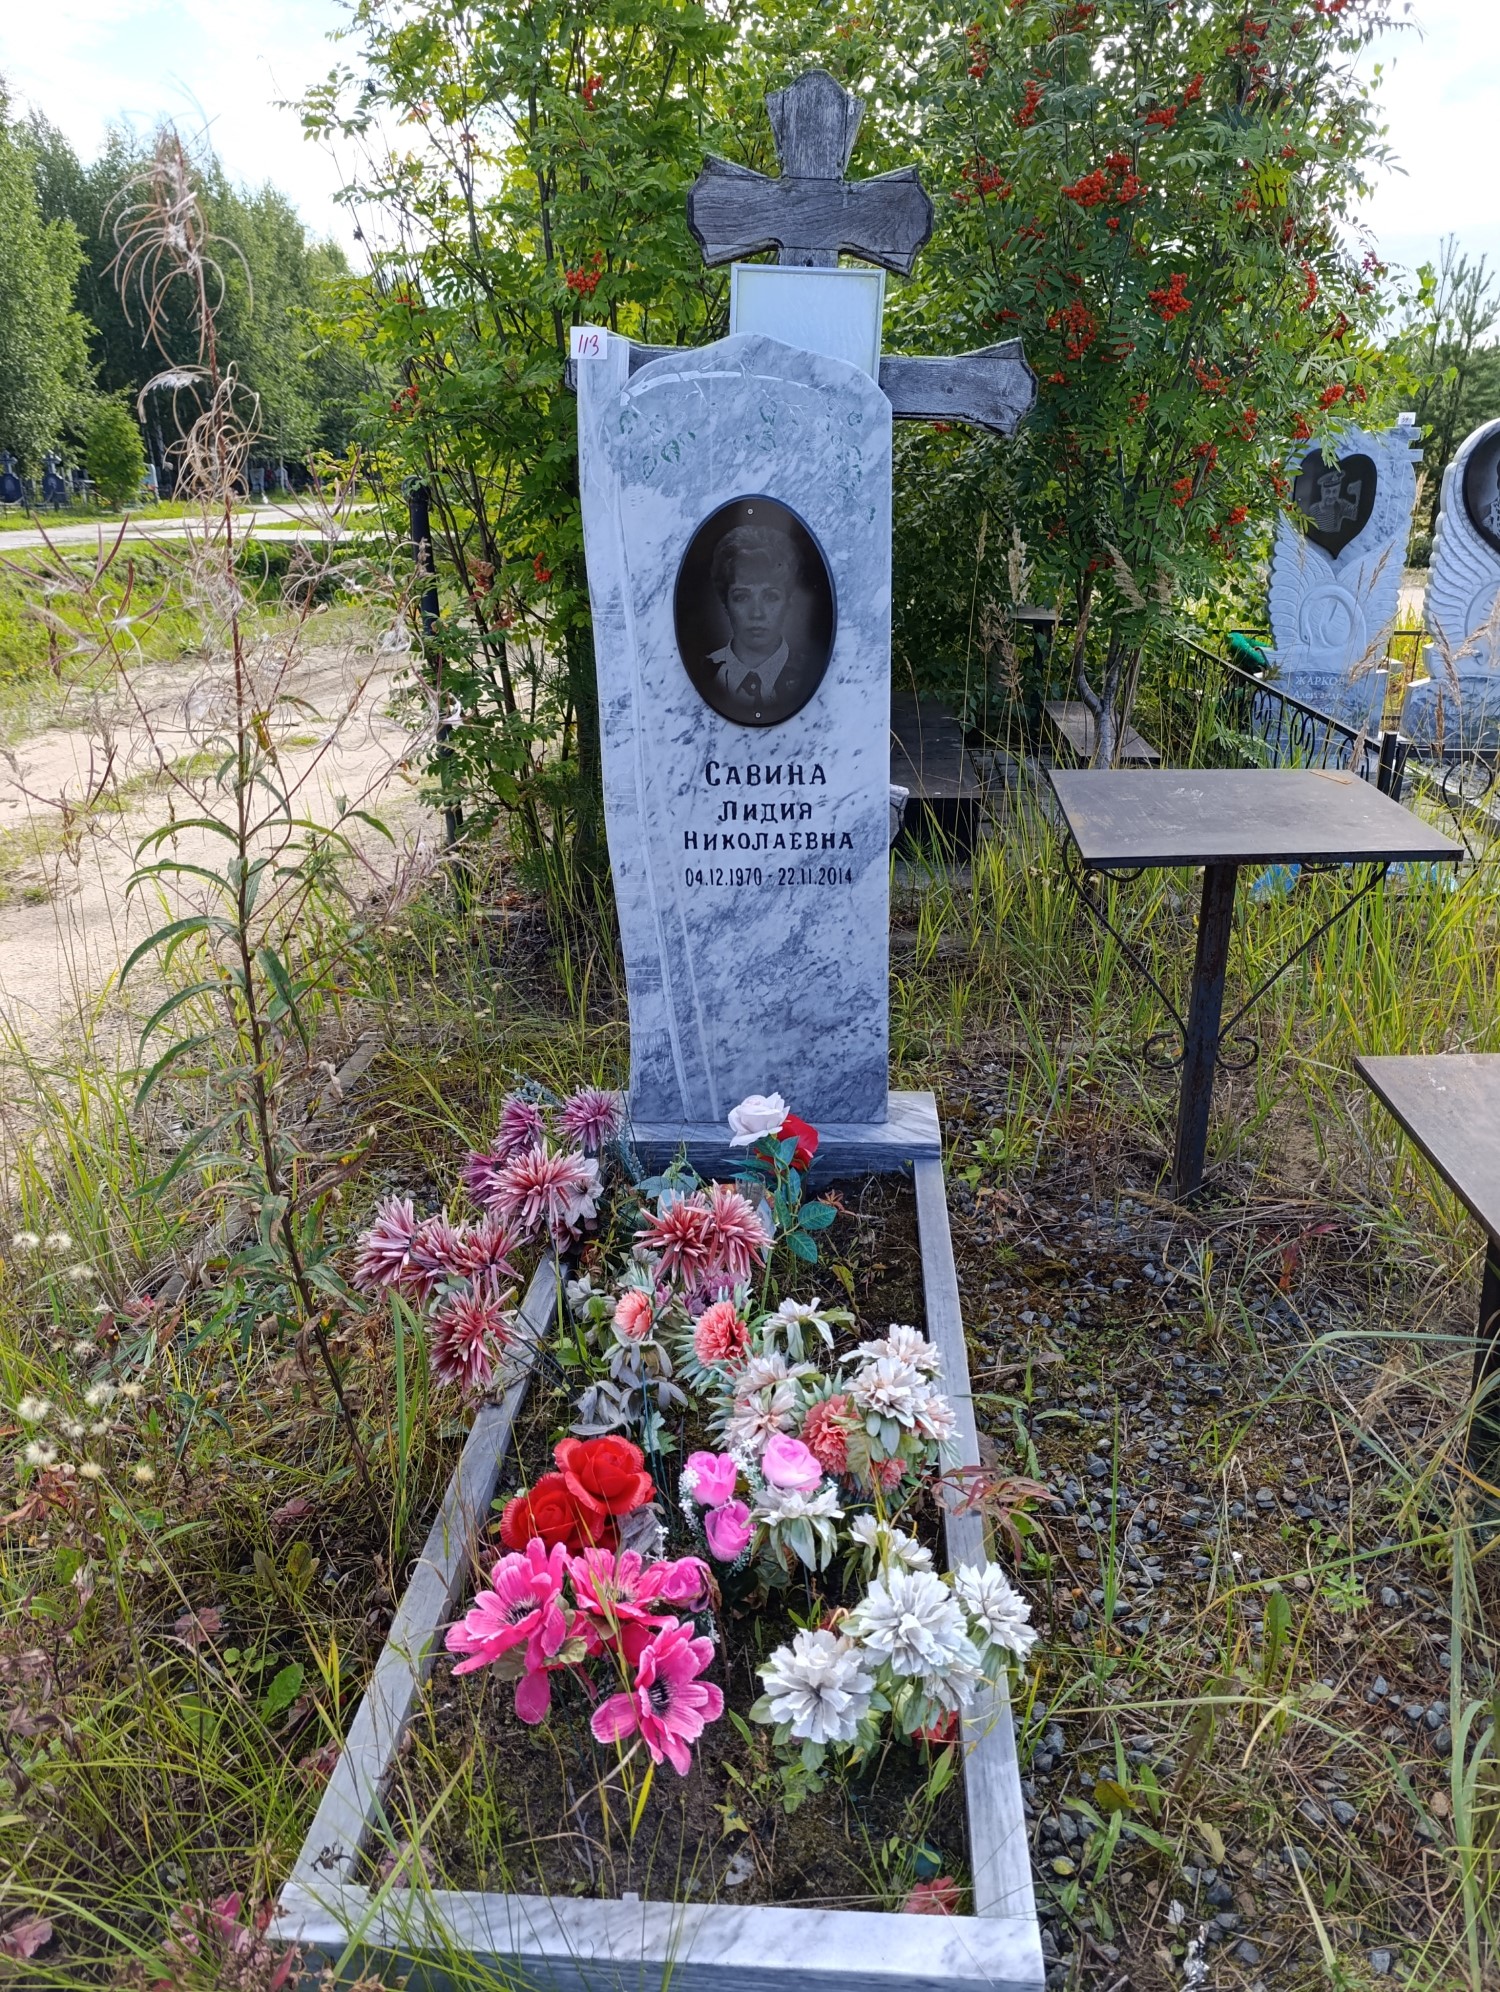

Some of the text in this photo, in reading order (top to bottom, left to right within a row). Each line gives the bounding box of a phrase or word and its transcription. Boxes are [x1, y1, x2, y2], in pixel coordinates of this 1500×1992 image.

[578, 333, 600, 357] 113
[1295, 676, 1345, 686] ЖАРКОВ
[705, 761, 827, 786] САВИНА
[718, 800, 813, 824] ЛИДИЯ
[684, 831, 854, 851] НИКОЛАЕВНА
[685, 867, 762, 887] 04.12.1970
[778, 867, 852, 887] 22.11.2014
